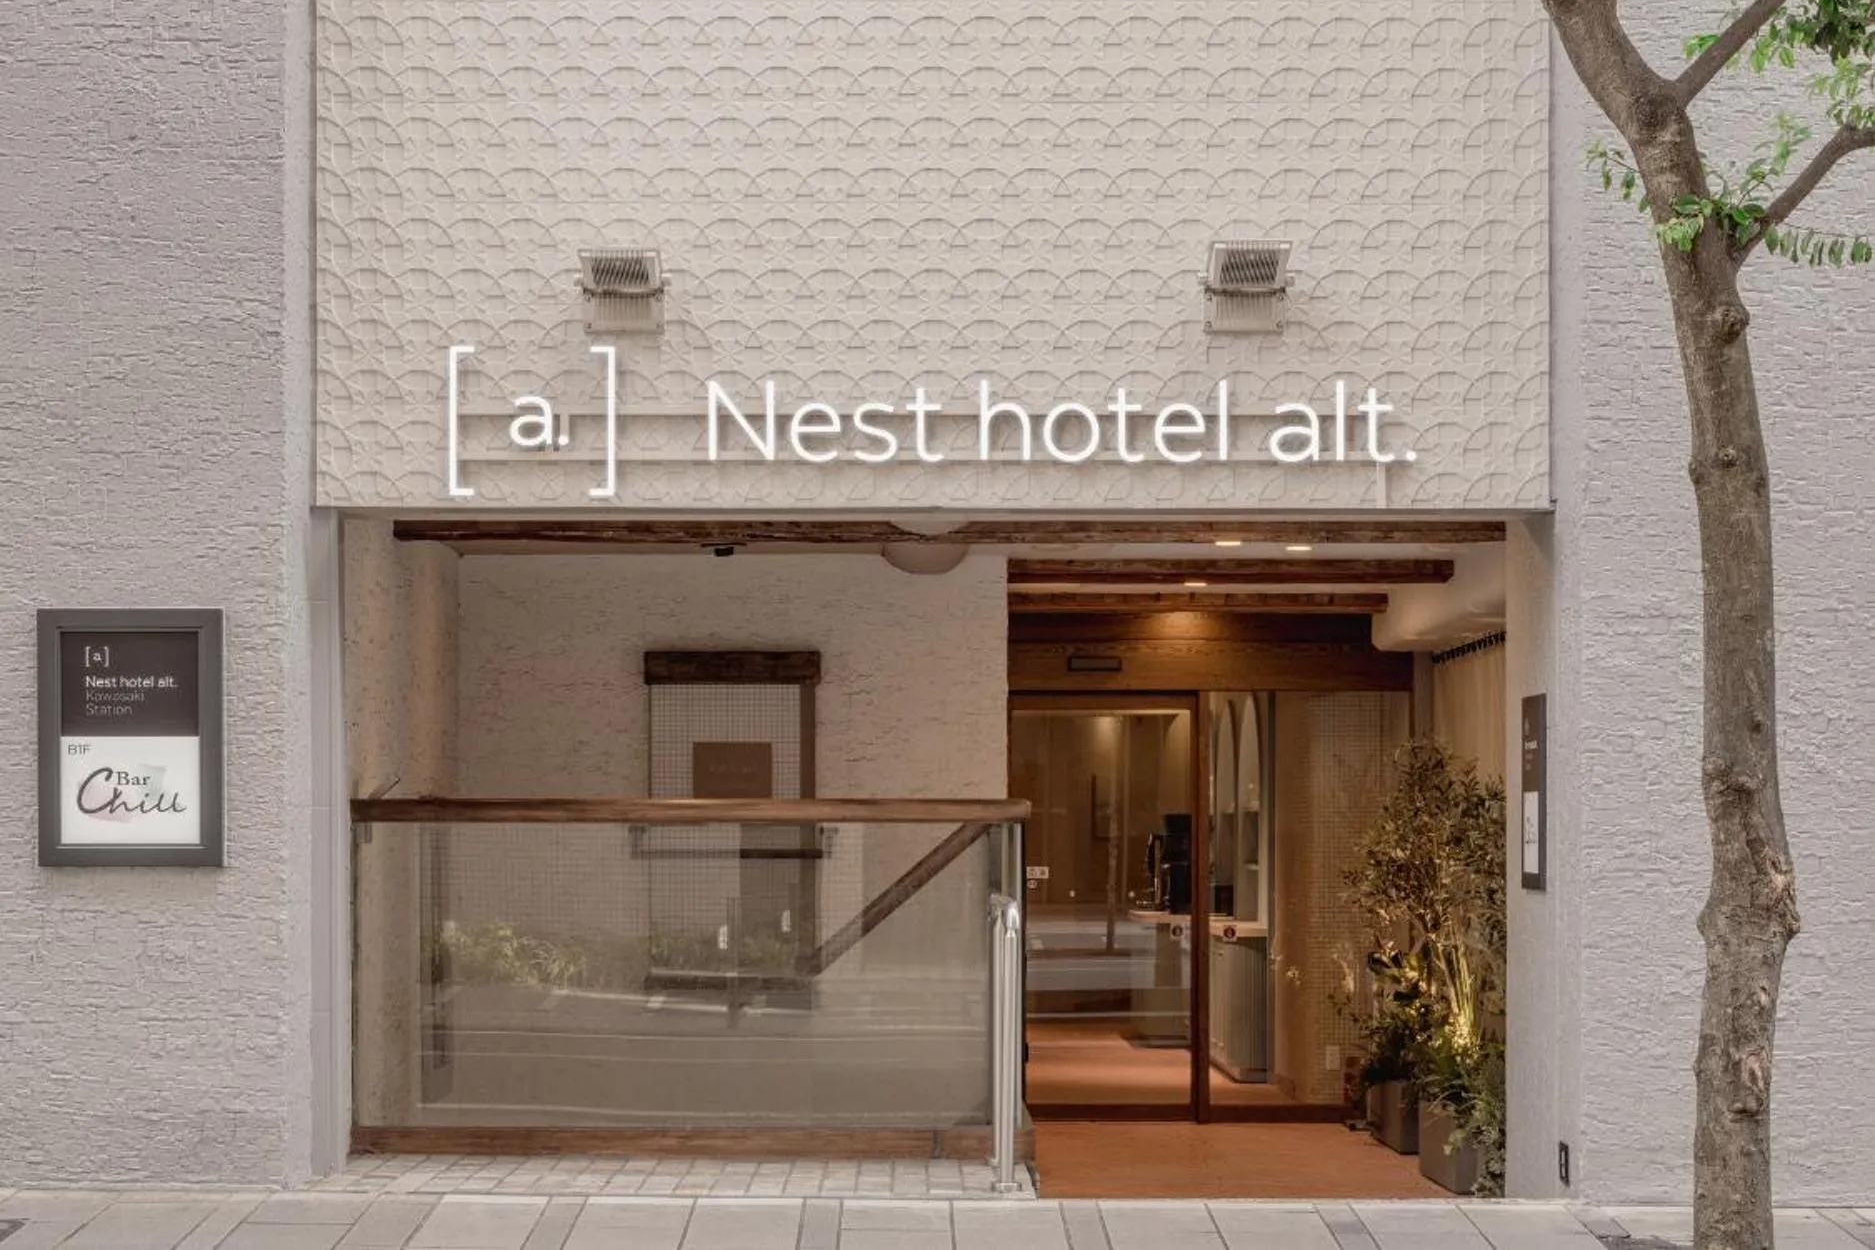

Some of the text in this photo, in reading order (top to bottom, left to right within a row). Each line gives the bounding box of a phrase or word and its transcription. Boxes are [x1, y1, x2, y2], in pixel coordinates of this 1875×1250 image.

[707, 380, 944, 463] Nest
[979, 379, 1229, 463] hotel
[1268, 379, 1418, 463] alt.
[84, 675, 179, 688] Nest hotel alt.
[85, 703, 133, 716] Station
[67, 743, 92, 756] B1F
[116, 770, 151, 786] Bar
[76, 766, 187, 815] Chill
